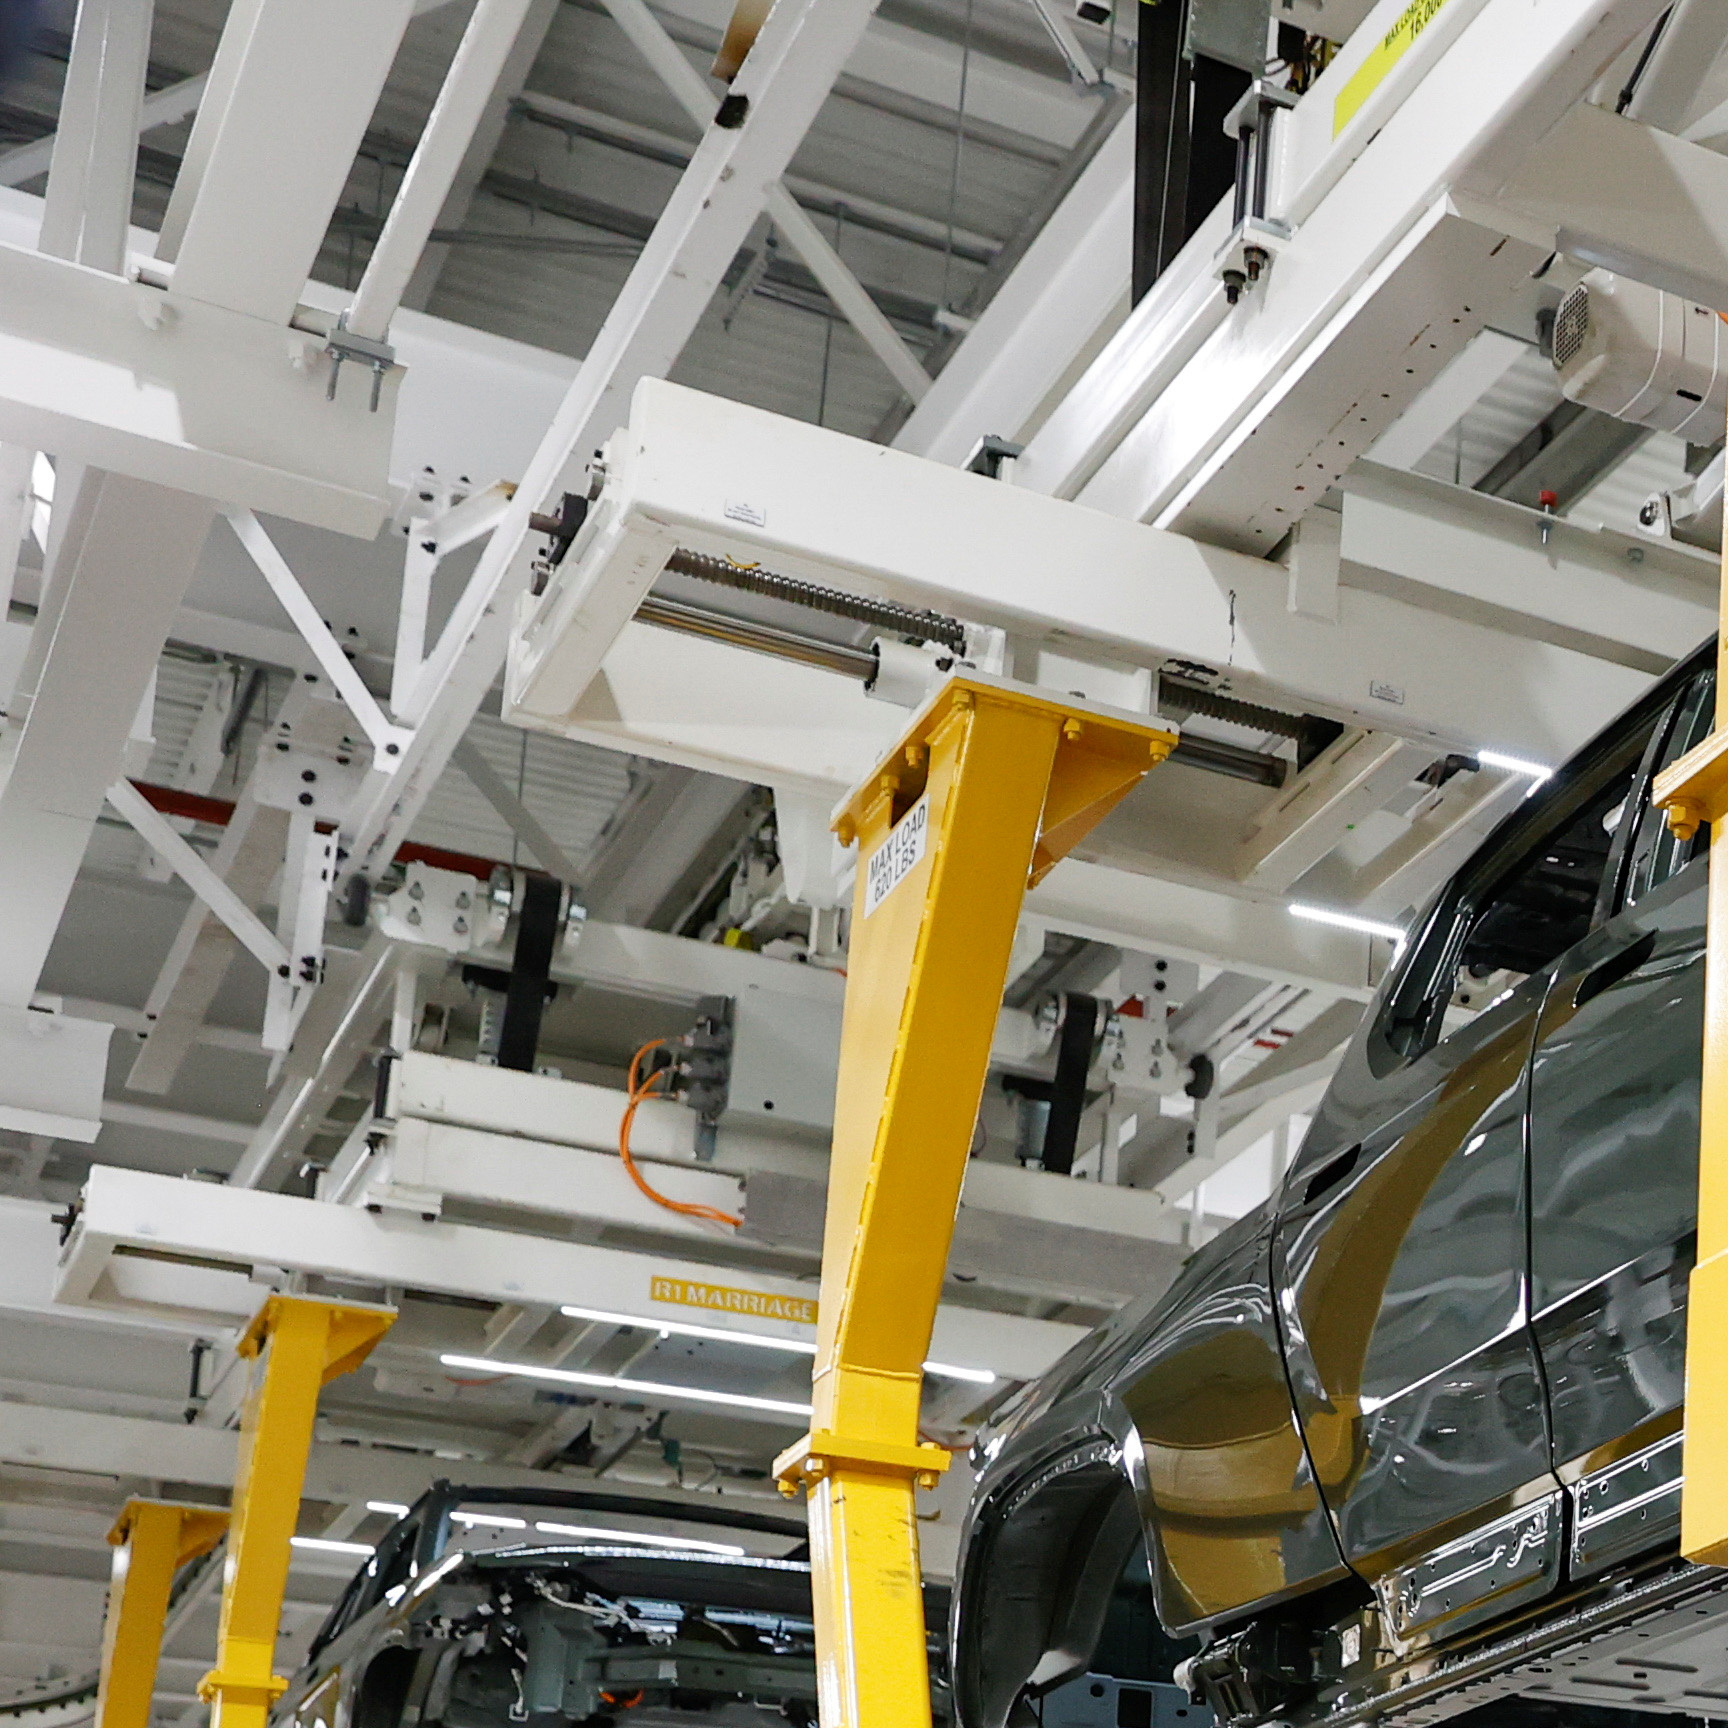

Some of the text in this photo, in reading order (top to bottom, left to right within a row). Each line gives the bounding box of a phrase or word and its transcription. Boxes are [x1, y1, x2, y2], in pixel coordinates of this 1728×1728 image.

[870, 804, 926, 881] MAX LOAD
[875, 840, 917, 902] 620 LBS
[686, 1285, 813, 1321] MARRIAGE
